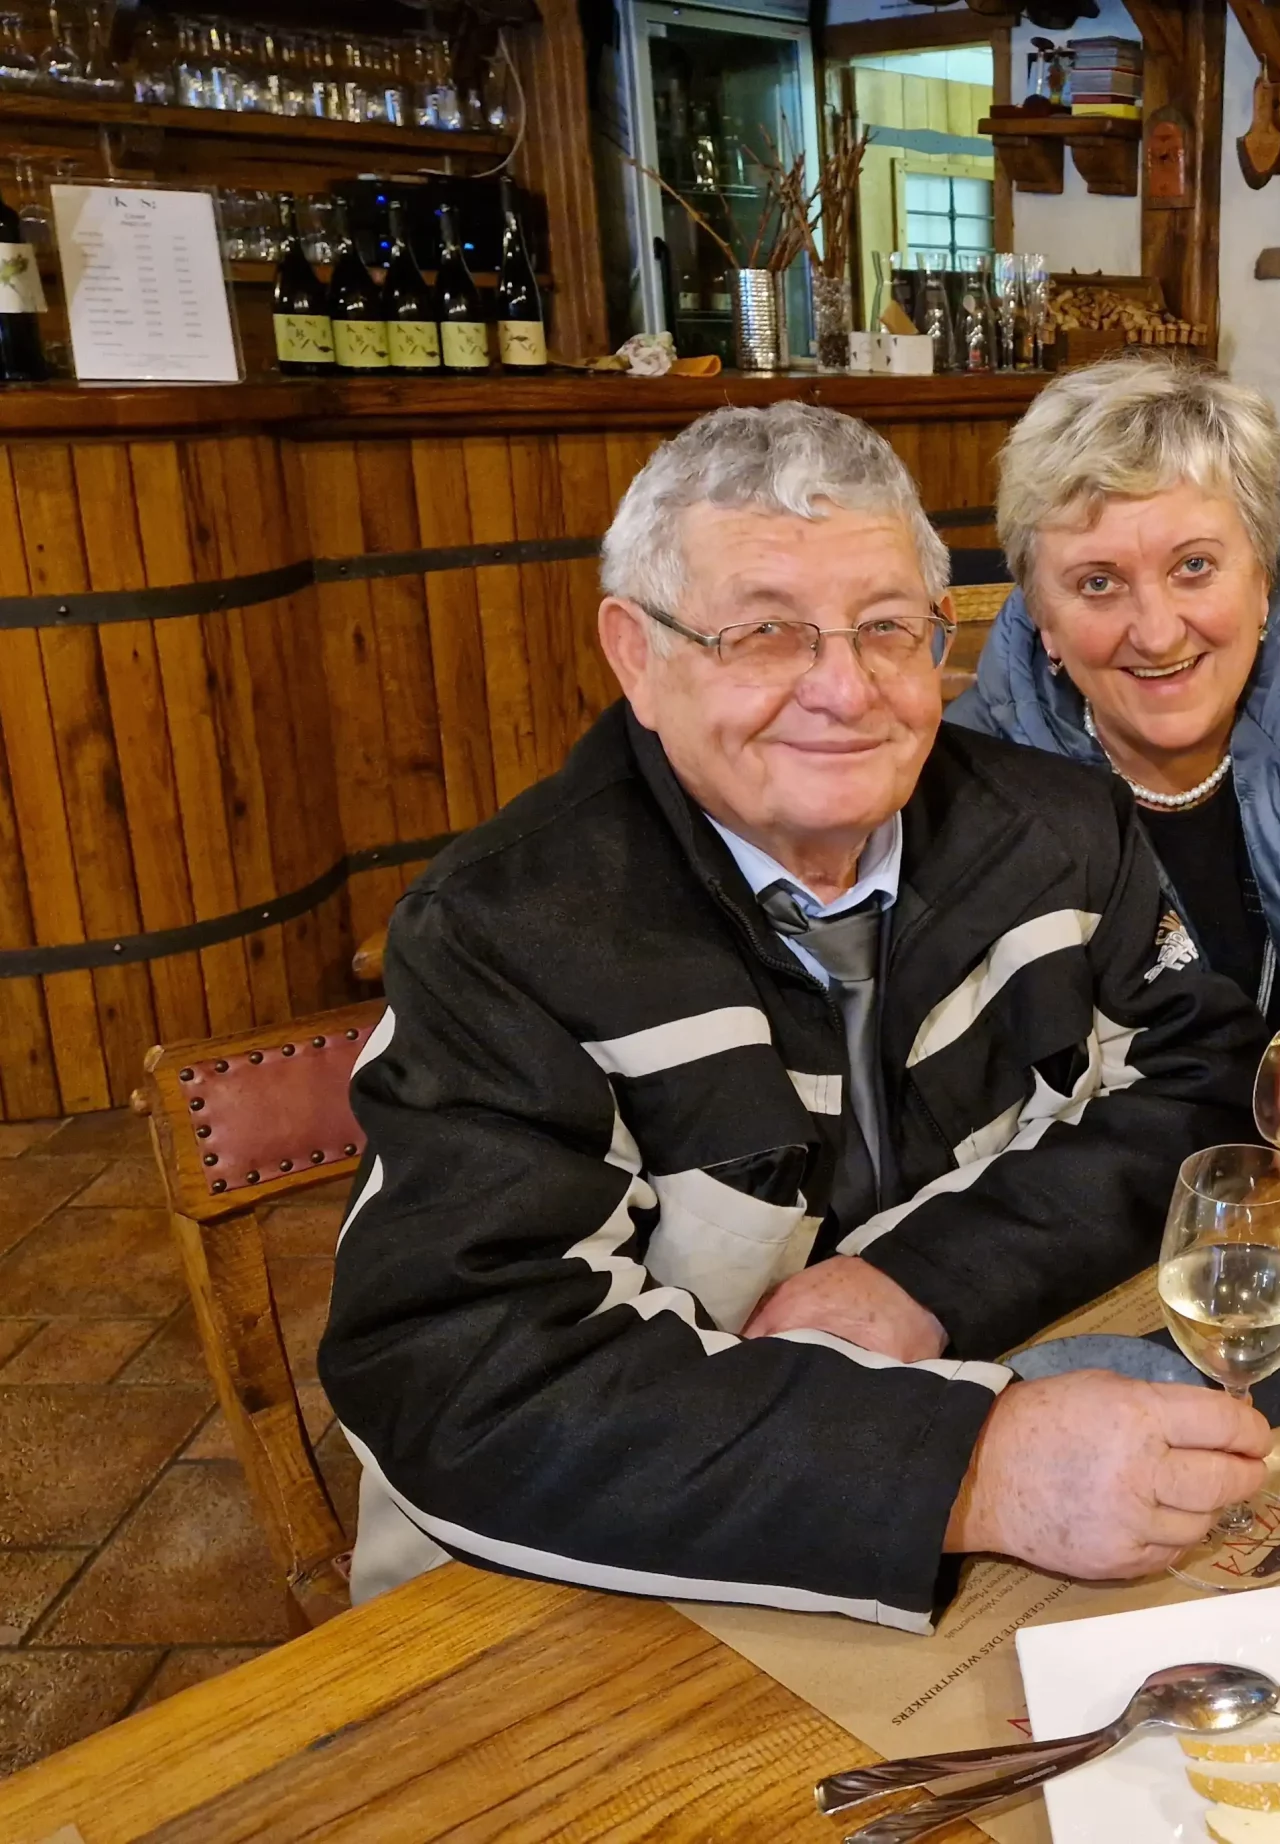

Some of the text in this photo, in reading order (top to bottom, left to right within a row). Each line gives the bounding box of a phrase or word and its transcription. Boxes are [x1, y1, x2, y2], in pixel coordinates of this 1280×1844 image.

[976, 1596, 1000, 1616] Wein
[1000, 1601, 1046, 1638] GEBOTE
[979, 1634, 1005, 1656] DES
[890, 1654, 982, 1727] WEINTRINKERS
